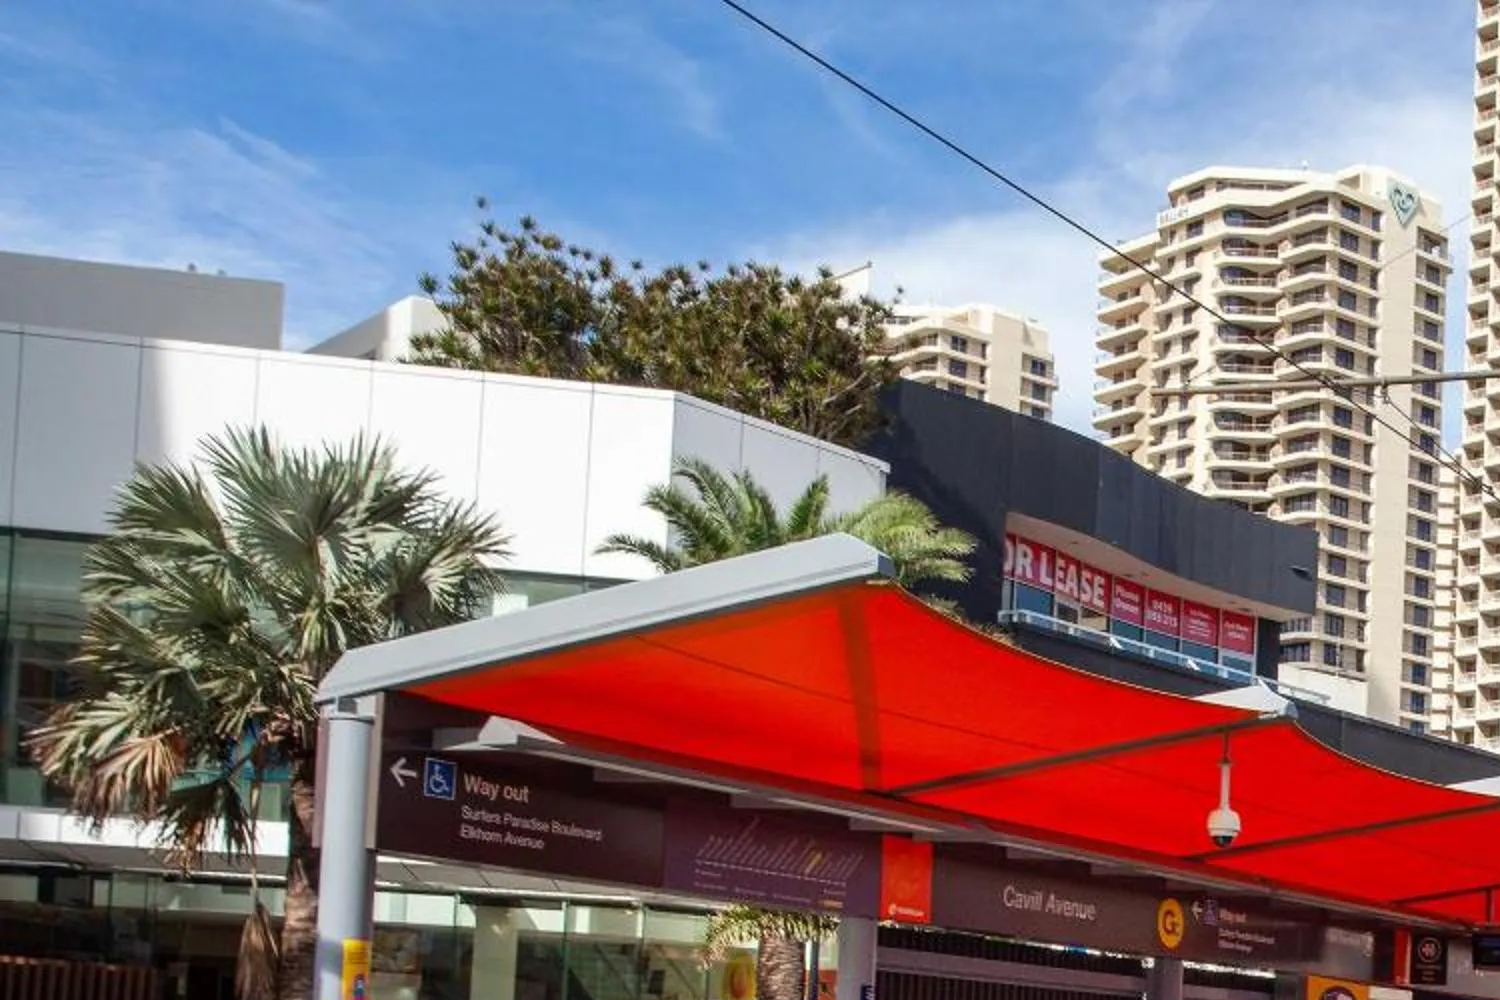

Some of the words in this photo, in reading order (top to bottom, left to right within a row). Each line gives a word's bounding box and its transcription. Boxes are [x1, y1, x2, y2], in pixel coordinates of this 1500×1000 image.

[1040, 551, 1105, 609] LEASE
[463, 773, 501, 800] Way
[503, 785, 530, 804] out
[503, 812, 550, 833] Paradise
[551, 819, 602, 841] Boulevard
[504, 831, 546, 849] Avenue
[1003, 885, 1043, 911] Cavill
[1045, 893, 1097, 921] Avenue
